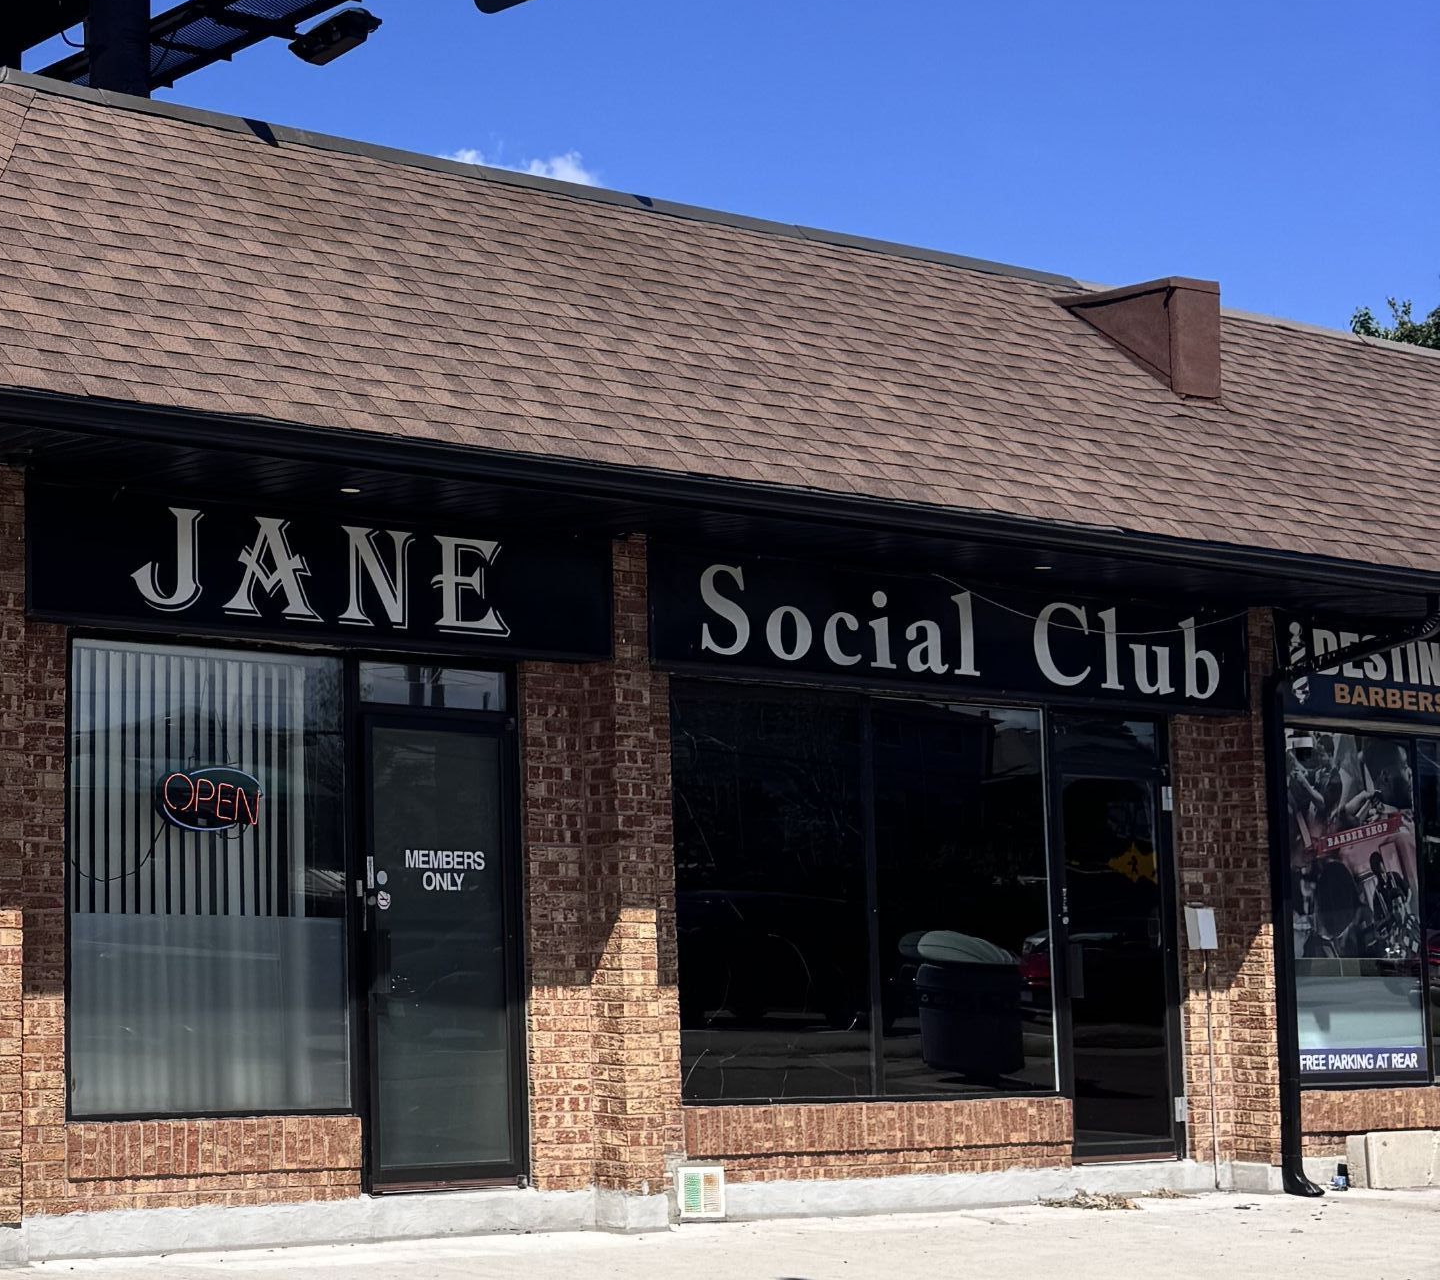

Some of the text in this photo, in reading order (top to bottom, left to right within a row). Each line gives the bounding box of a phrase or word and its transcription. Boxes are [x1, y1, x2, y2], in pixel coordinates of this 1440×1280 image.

[131, 506, 512, 638] JANE
[699, 564, 1221, 700] Social Club
[164, 772, 261, 826] OPEN
[1327, 823, 1389, 847] BARBER SHOP
[405, 849, 486, 871] MEMBERS
[422, 871, 465, 891] ONLY
[1299, 1053, 1418, 1070] FREE PARKING AT REAR
